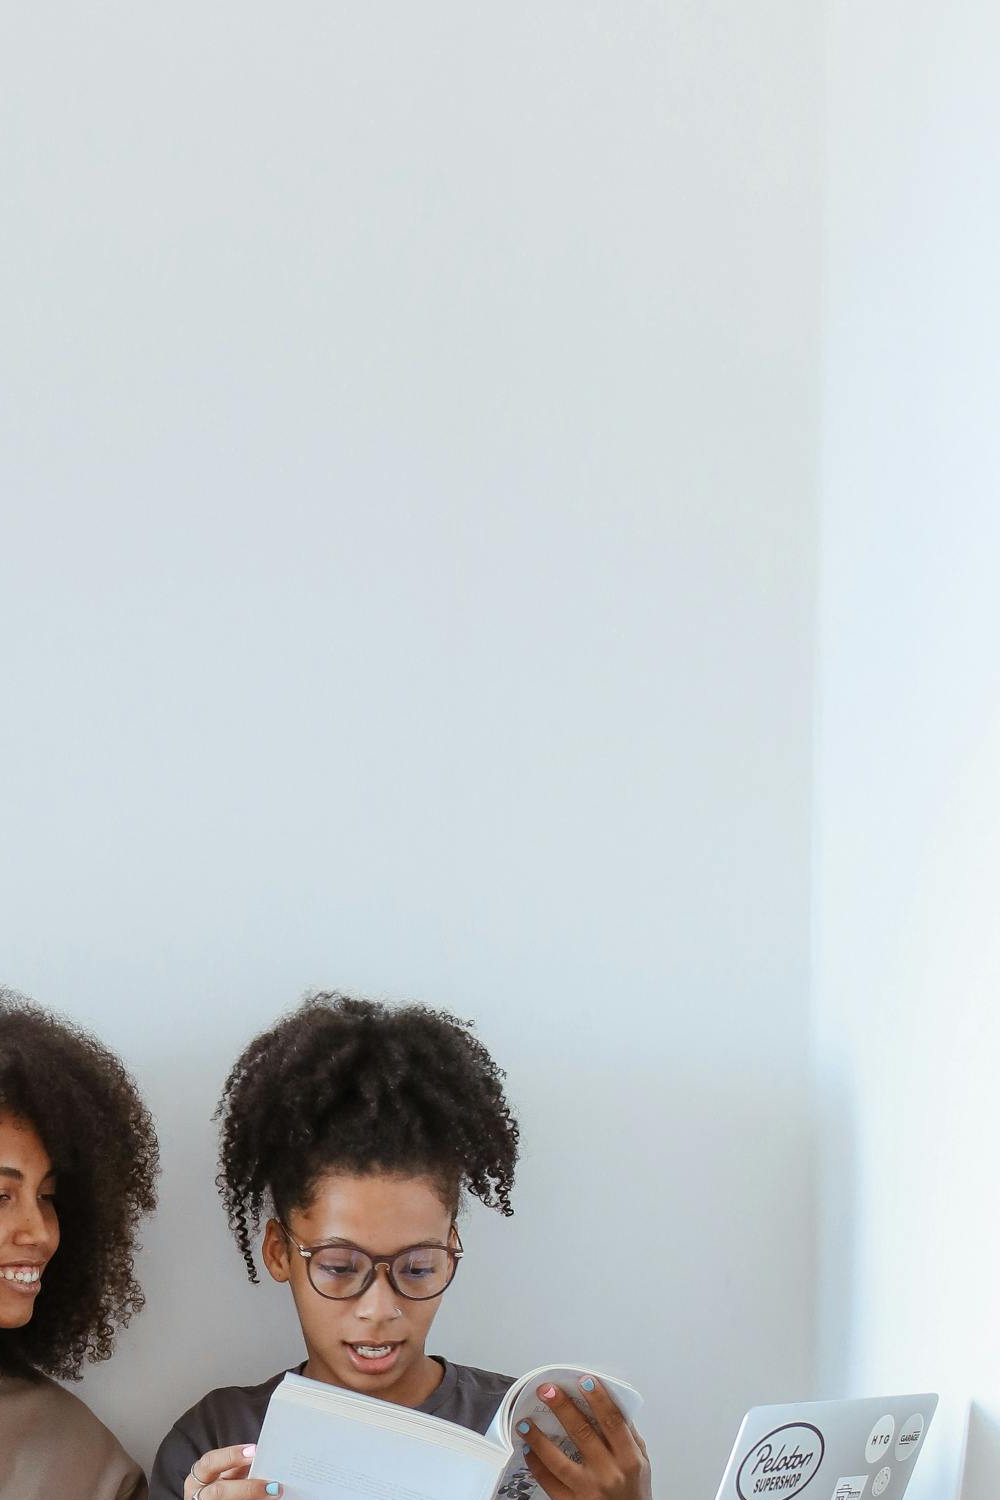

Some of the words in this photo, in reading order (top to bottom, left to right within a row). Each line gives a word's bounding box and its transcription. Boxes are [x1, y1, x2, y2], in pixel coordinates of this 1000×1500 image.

[900, 1433, 920, 1443] GARAGE
[751, 1443, 814, 1476] Peloton
[753, 1473, 802, 1493] SUPERSHOP
